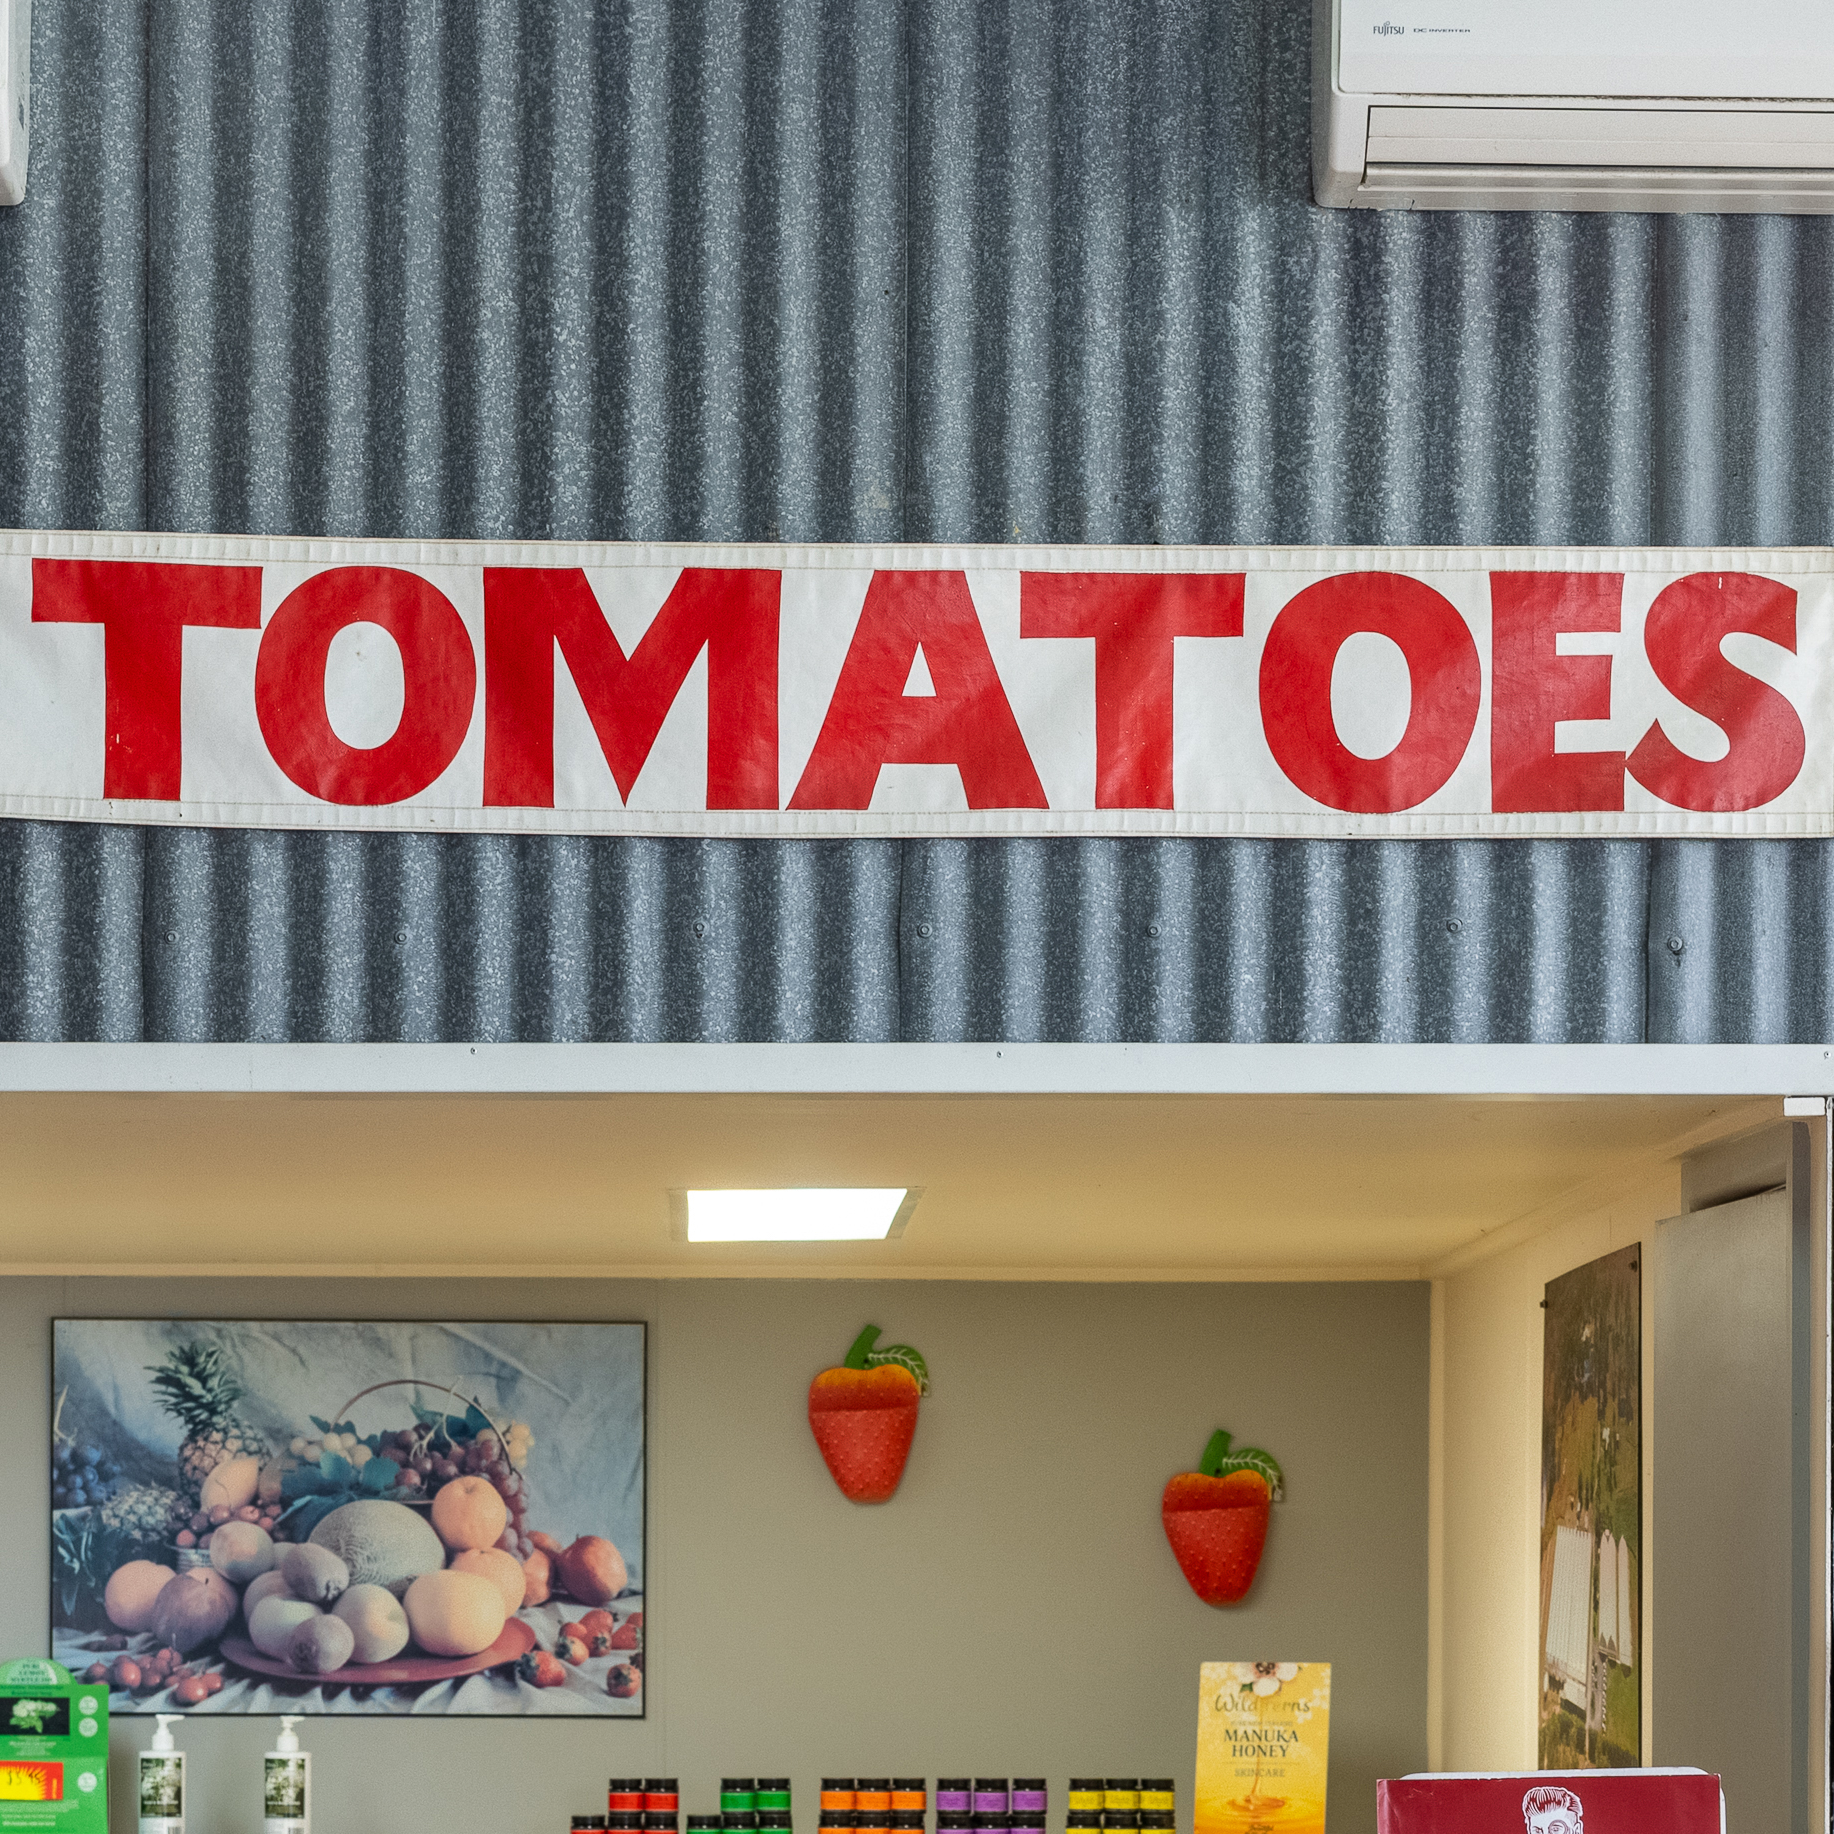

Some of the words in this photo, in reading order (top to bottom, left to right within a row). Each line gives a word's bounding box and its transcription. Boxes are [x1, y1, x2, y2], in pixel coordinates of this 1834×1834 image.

[1373, 20, 1405, 37] FUJITSU
[32, 558, 1805, 814] TOMATOES
[1224, 1729, 1299, 1744] MANUKA
[1231, 1744, 1289, 1758] HONEY
[1234, 1769, 1286, 1778] SKINCARE
